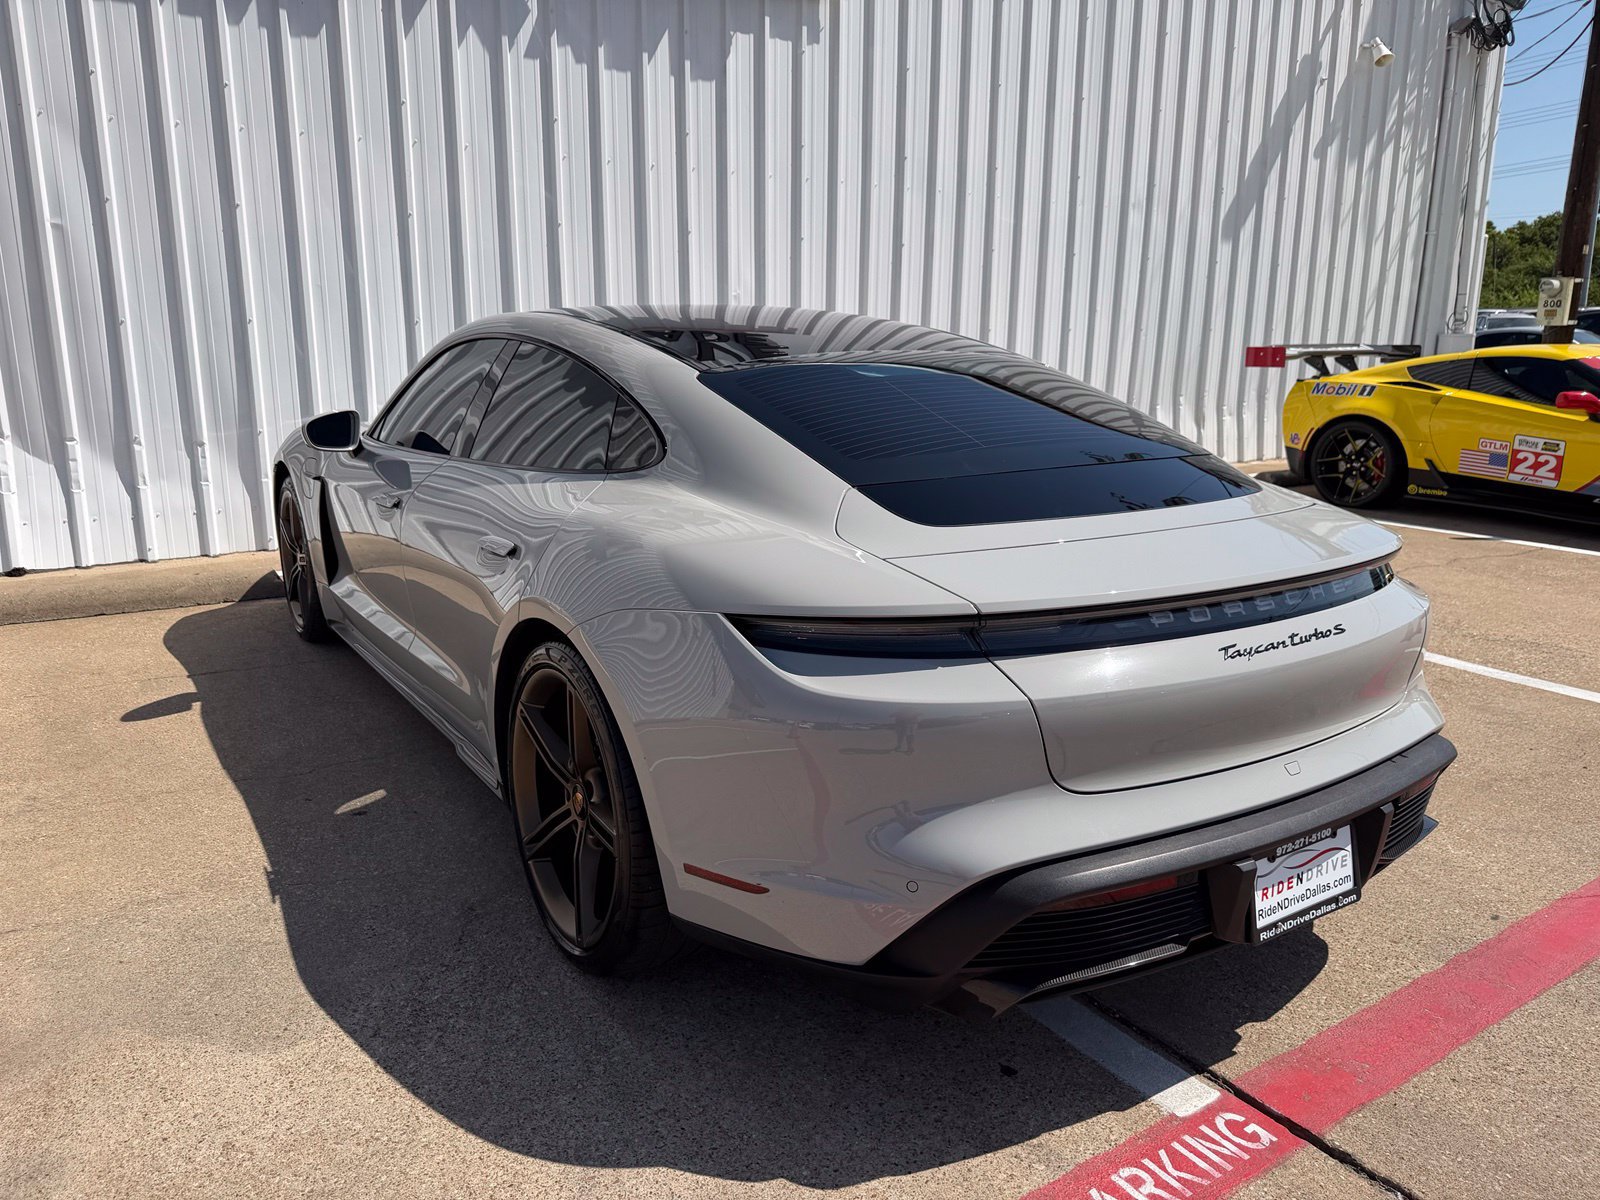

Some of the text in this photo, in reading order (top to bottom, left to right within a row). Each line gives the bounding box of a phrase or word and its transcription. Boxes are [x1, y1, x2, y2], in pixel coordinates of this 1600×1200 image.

[1543, 299, 1562, 308] 800
[1311, 381, 1358, 396] Mobil
[1480, 440, 1508, 451] GTLM
[1514, 451, 1557, 479] 22
[1148, 581, 1350, 628] PORSCHE
[1276, 827, 1332, 857] 972-271-5100
[1257, 873, 1352, 922] RideNDriveDallas.com
